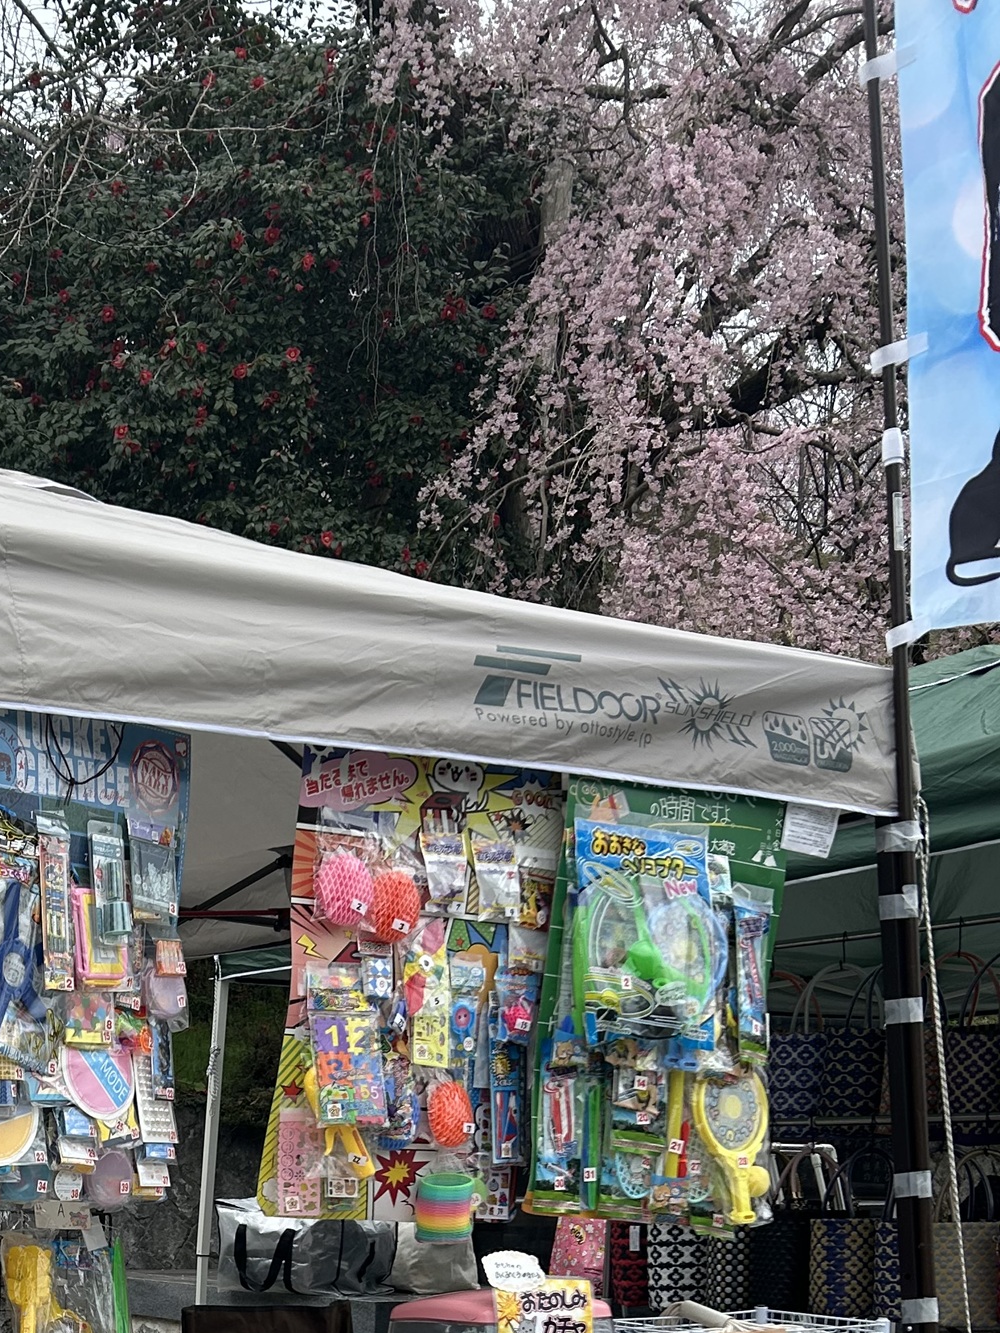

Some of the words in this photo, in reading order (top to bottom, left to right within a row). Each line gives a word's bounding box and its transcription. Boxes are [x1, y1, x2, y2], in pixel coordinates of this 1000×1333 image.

[515, 678, 661, 725] FIELDOOR
[475, 707, 548, 729] Powered
[555, 713, 575, 736] by
[580, 718, 653, 748] ottostyle.jp
[15, 750, 130, 808] CHANCE
[340, 768, 410, 803] 帰れません。
[650, 795, 736, 829] の時間ですよ。
[591, 827, 646, 857] おおきな
[622, 856, 699, 881] ヘリコプター
[664, 880, 698, 899] New
[66, 979, 73, 989] 2
[624, 979, 630, 988] 2
[434, 997, 440, 1006] 5
[106, 1020, 112, 1030] 8
[324, 1025, 340, 1047] 1
[353, 1026, 368, 1050] 2
[49, 1063, 56, 1073] 5
[636, 1079, 646, 1088] 14
[370, 1086, 380, 1100] 5
[637, 1113, 649, 1122] 20
[669, 1141, 681, 1152] 21
[584, 1170, 595, 1180] 31
[37, 1182, 46, 1191] 34
[120, 1182, 129, 1192] 39
[554, 1178, 565, 1189] 30
[70, 1189, 79, 1199] 38
[57, 1203, 65, 1218] A
[521, 1289, 588, 1314] おたのしみ
